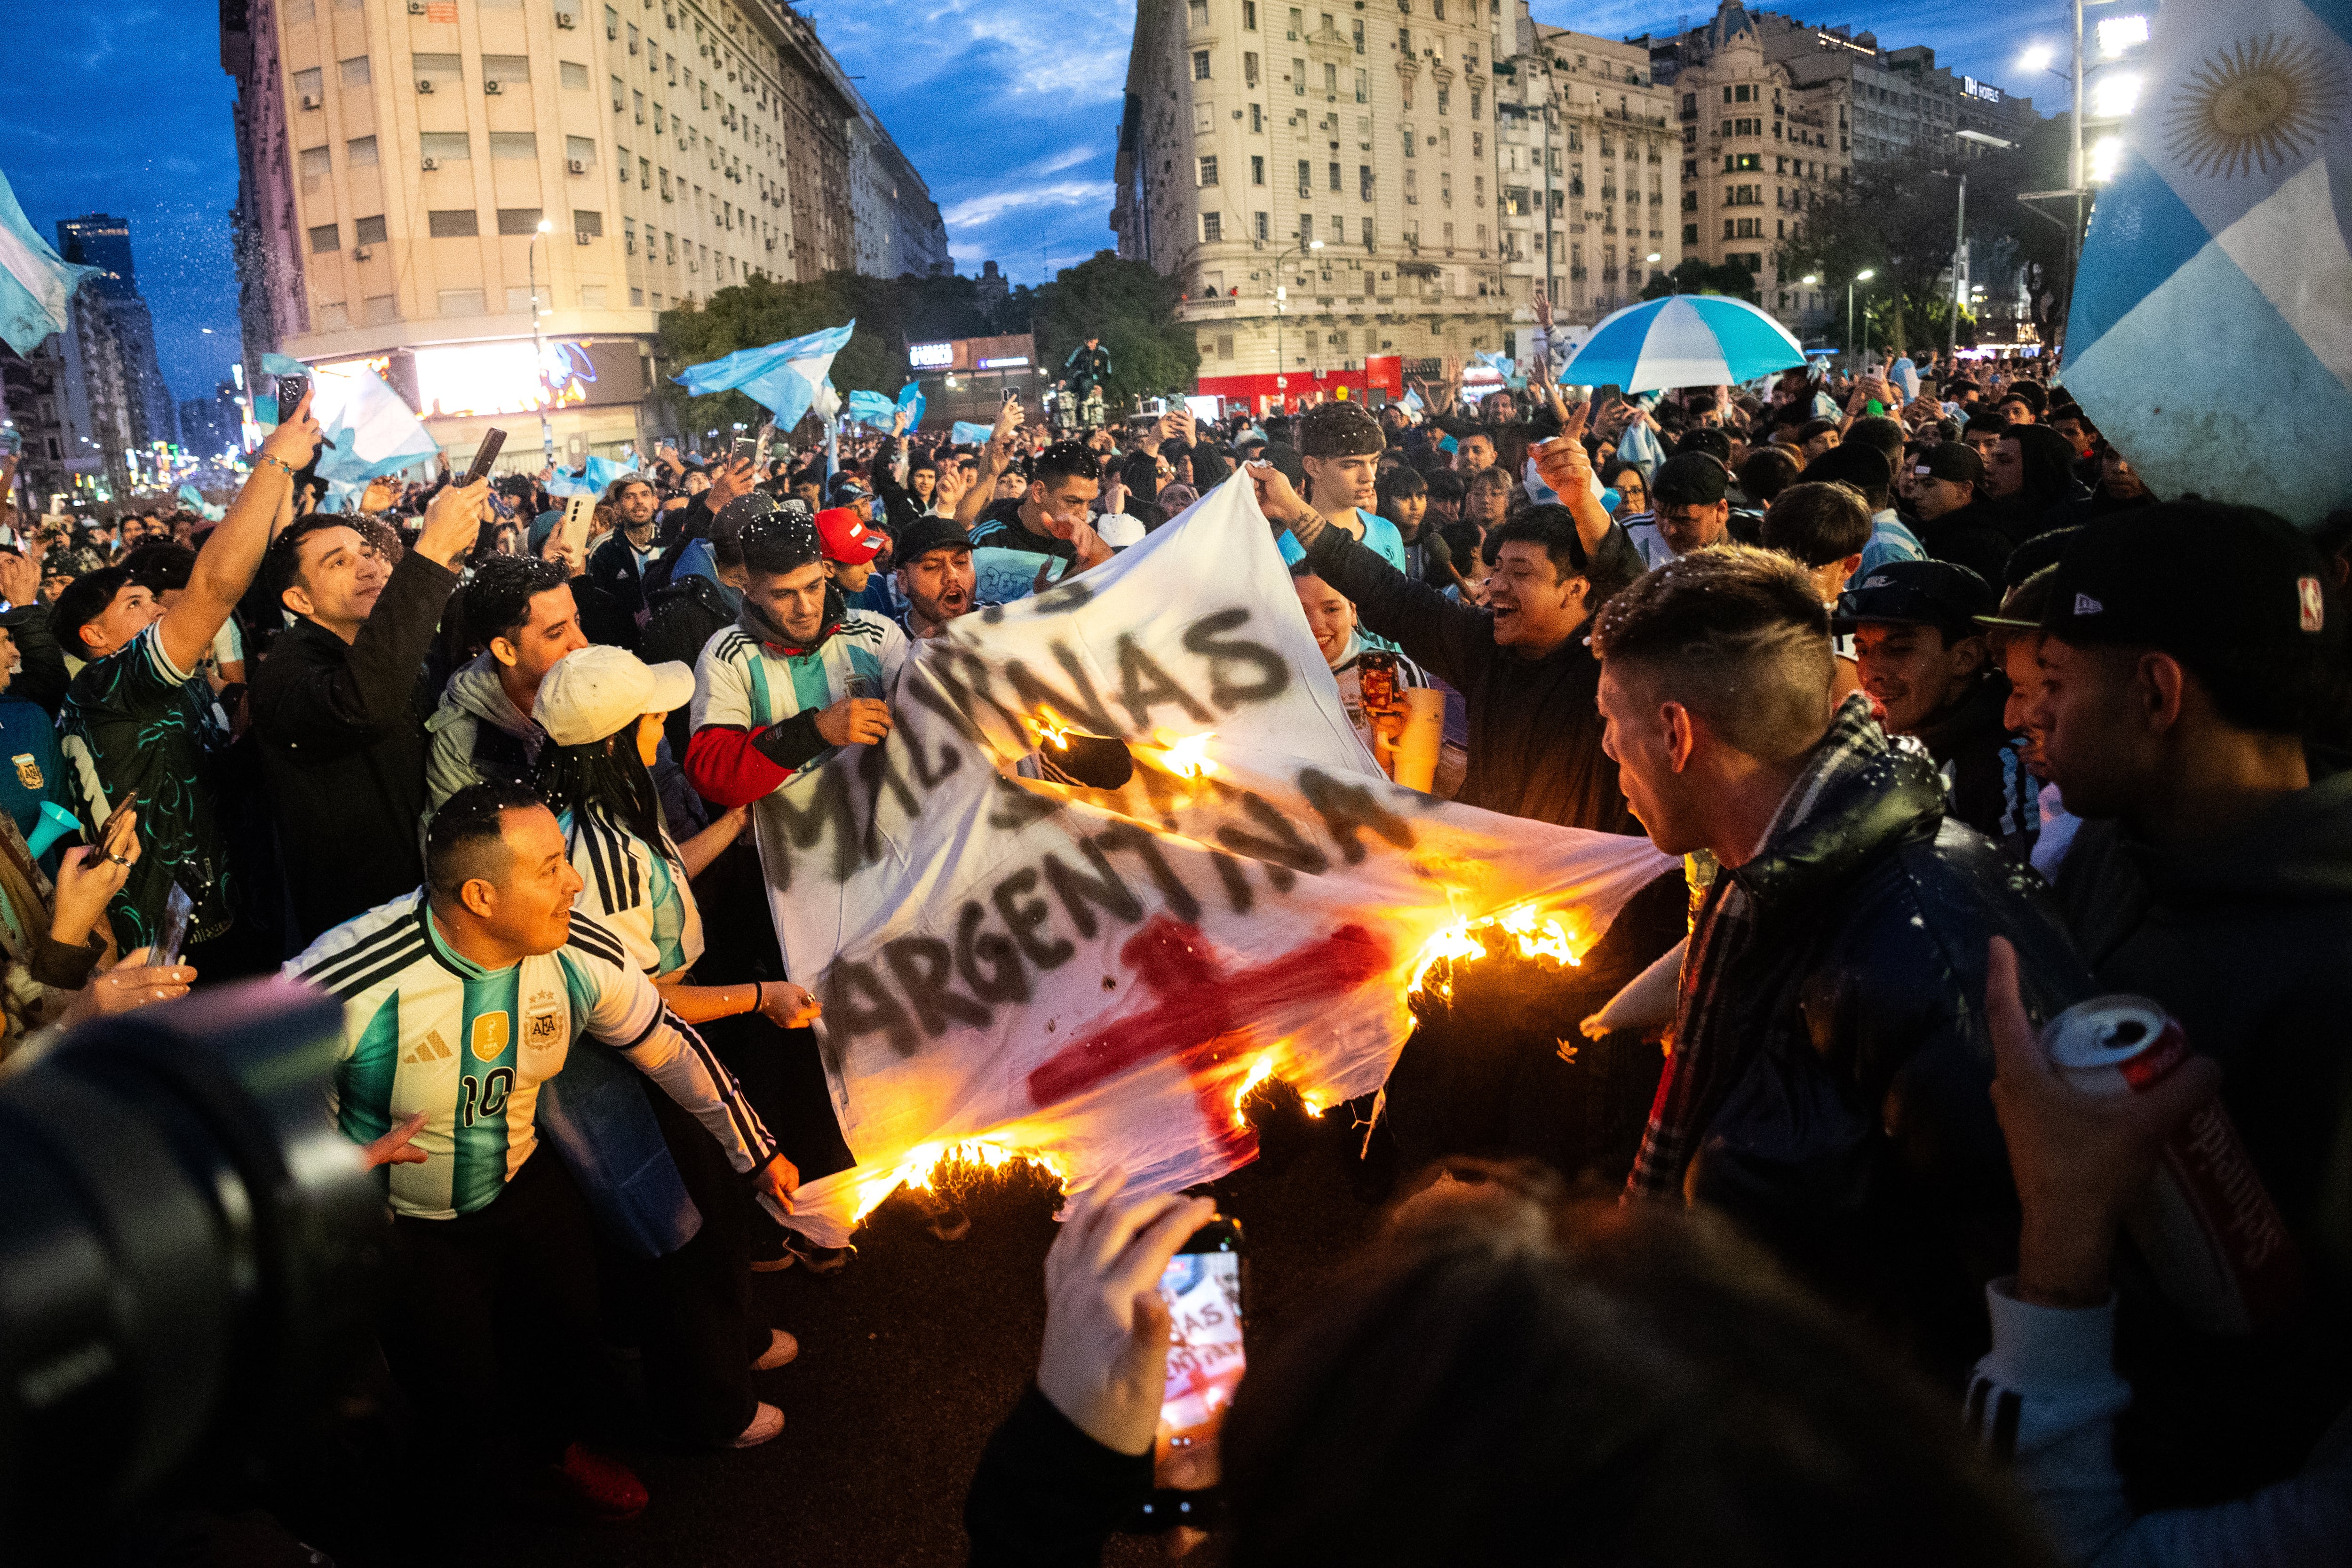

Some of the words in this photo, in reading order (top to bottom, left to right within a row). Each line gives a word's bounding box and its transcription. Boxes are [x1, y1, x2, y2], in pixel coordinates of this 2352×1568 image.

[532, 1014, 556, 1036] AFA
[462, 1066, 516, 1128] 10
[2186, 1106, 2282, 1271] Schneide
